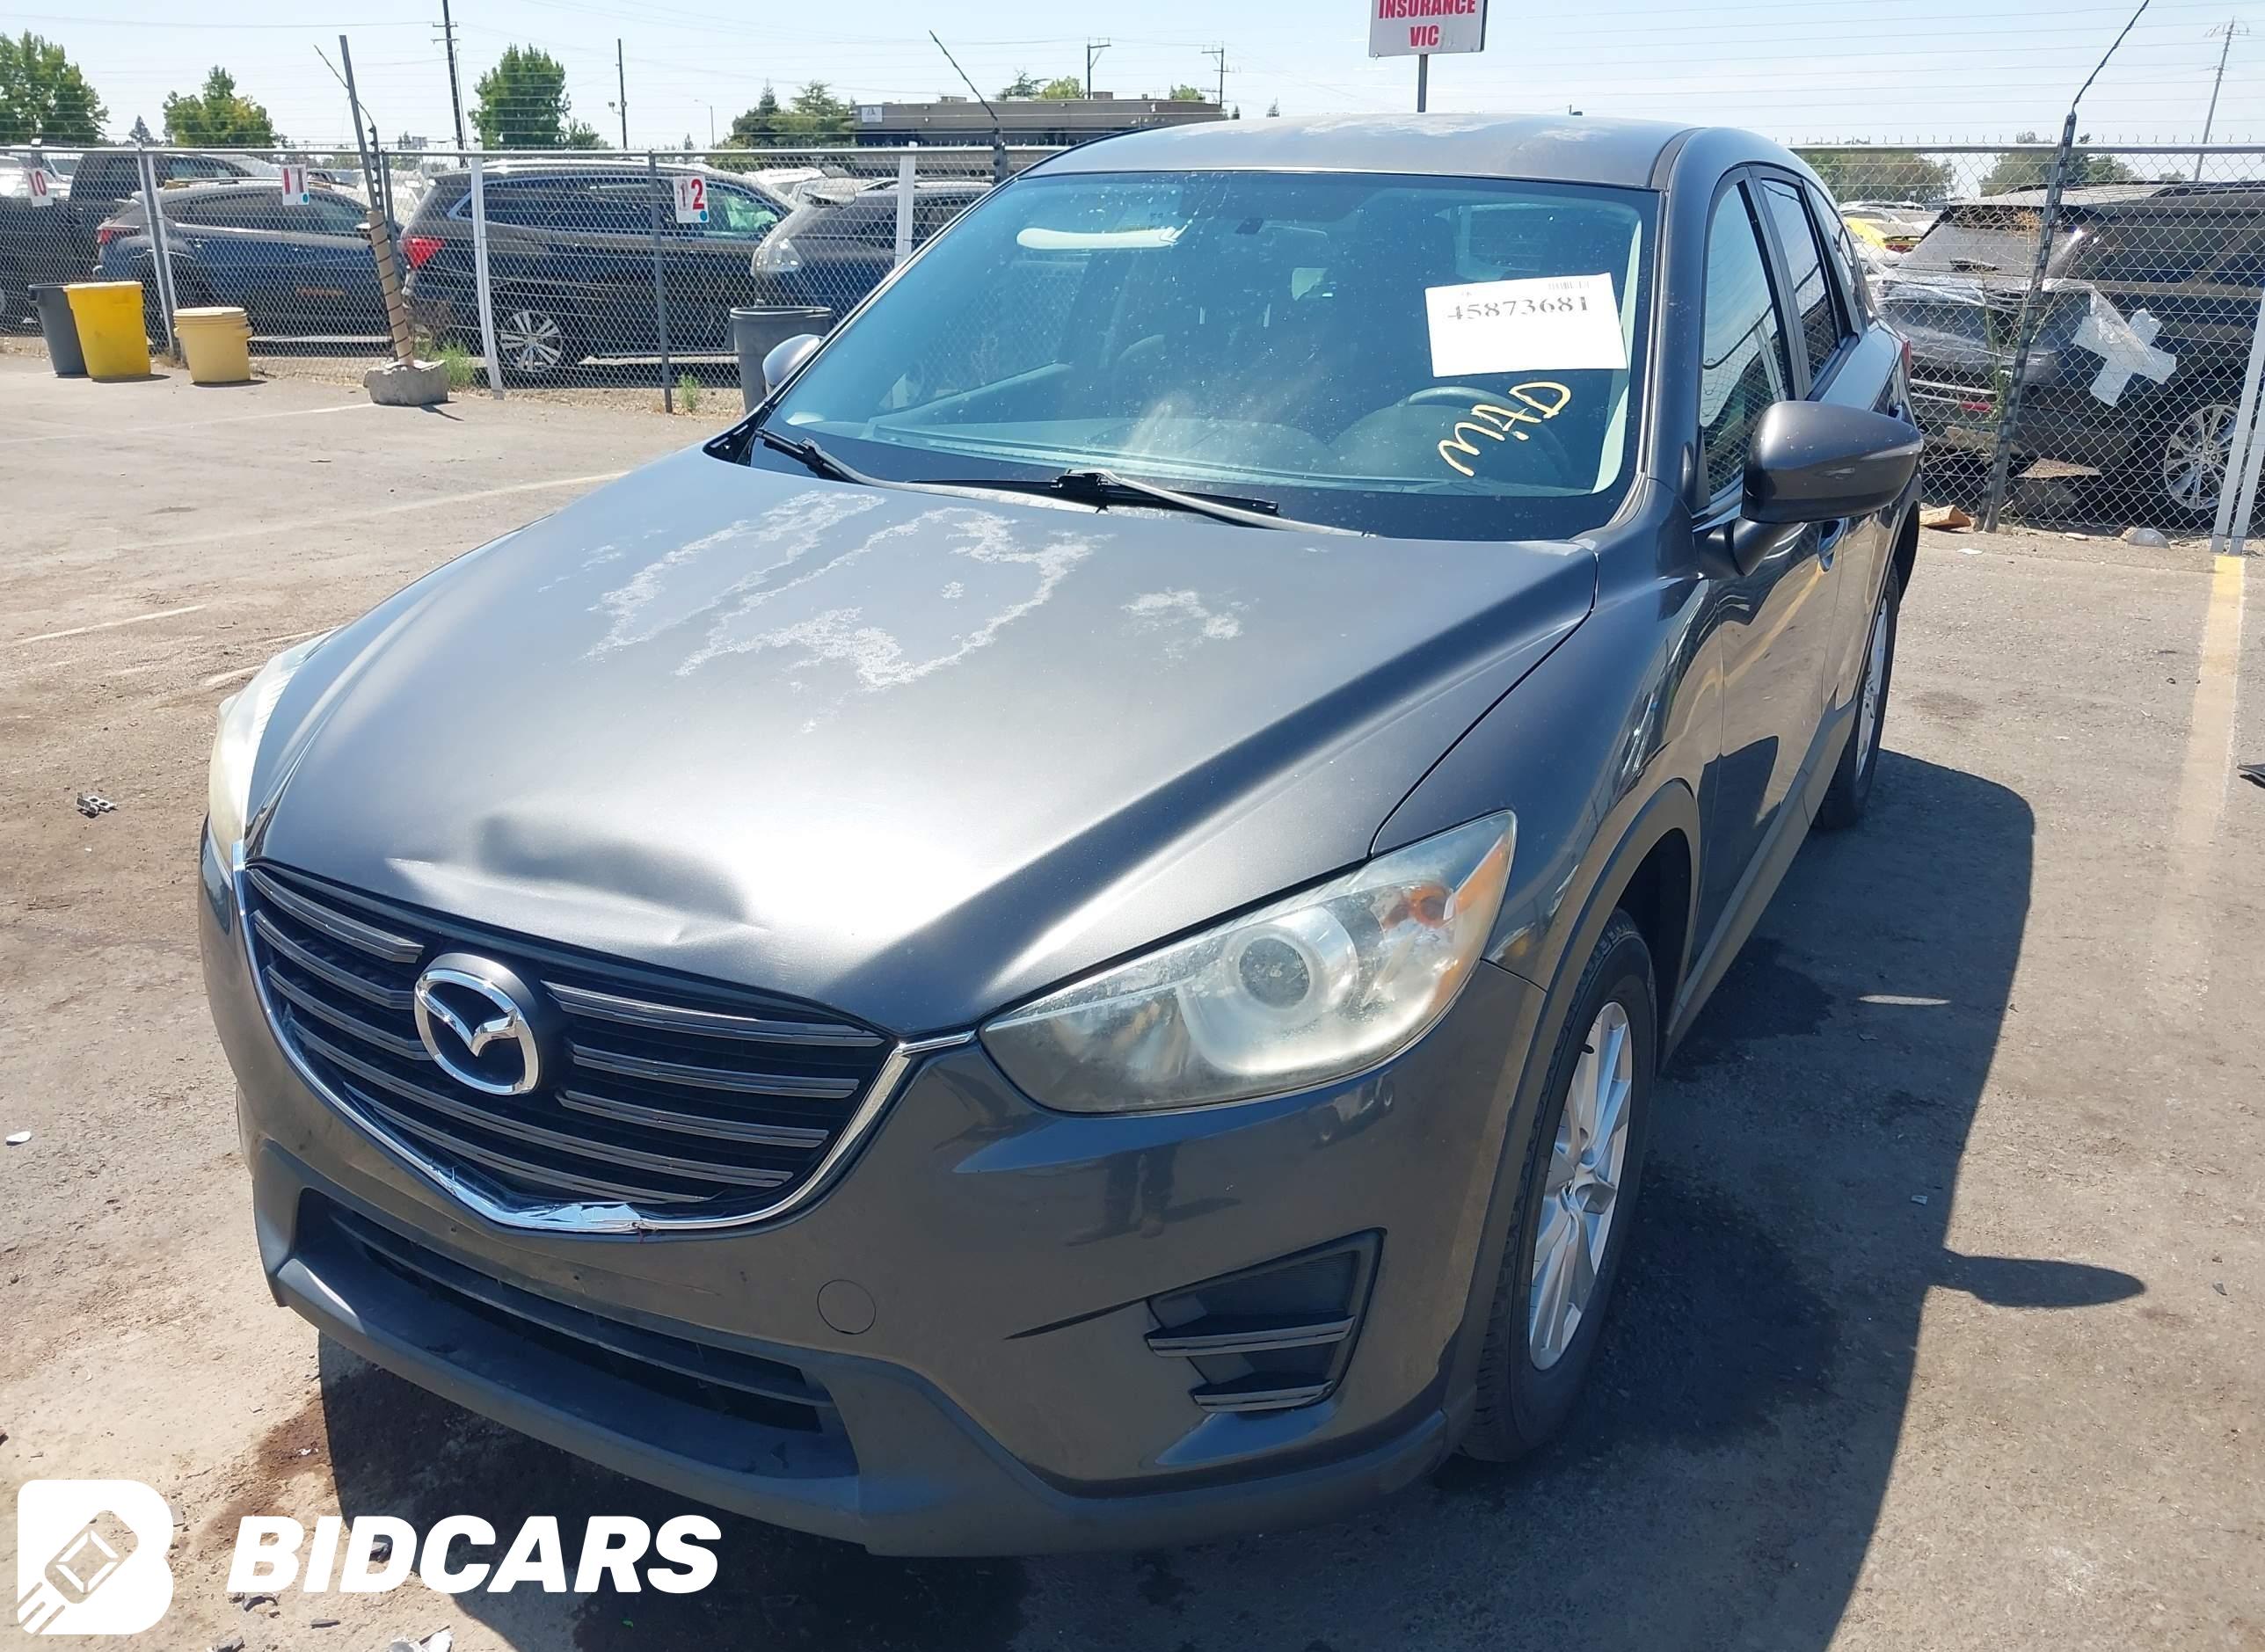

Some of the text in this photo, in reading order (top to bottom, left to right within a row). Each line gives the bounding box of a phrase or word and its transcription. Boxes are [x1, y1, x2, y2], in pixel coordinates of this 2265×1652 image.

[1378, 0, 1475, 18] INSURANCE
[1409, 25, 1439, 47] VIC
[28, 171, 47, 196] 10
[283, 168, 304, 194] 11
[680, 178, 704, 210] 12
[1447, 296, 1588, 320] 45873681
